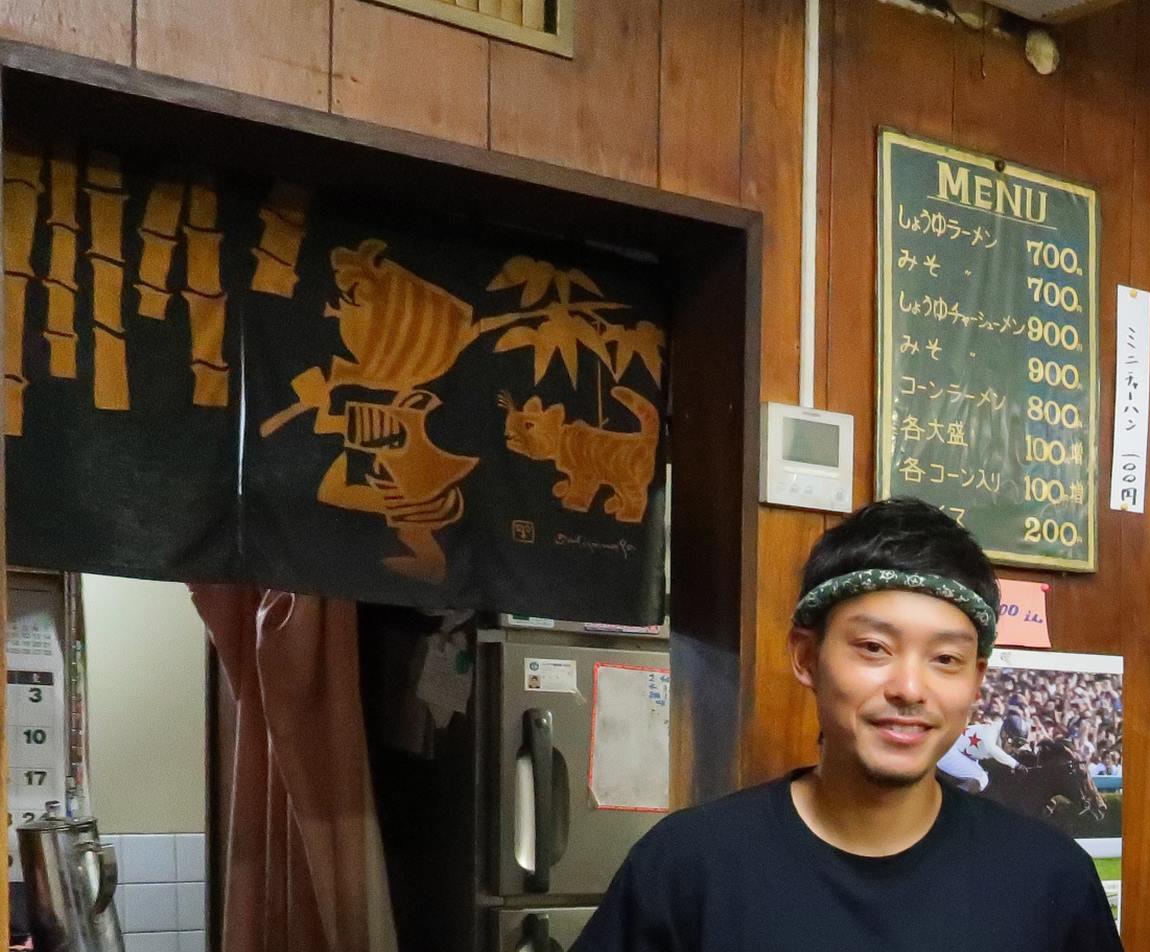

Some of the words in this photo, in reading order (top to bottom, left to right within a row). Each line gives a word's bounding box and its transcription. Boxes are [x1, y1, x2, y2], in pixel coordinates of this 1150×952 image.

[937, 160, 1048, 223] MENU
[899, 205, 997, 248] しょうゆラーメン
[899, 291, 1025, 334] しょうゆチャーシューメン
[901, 376, 1006, 410] コーンラーメン
[1124, 327, 1139, 431] ミニチャーハン
[900, 415, 968, 447] 各大盛
[899, 457, 1000, 493] 各コーン入り
[28, 687, 42, 703] 3
[23, 729, 47, 745] 10
[24, 770, 47, 786] 17
